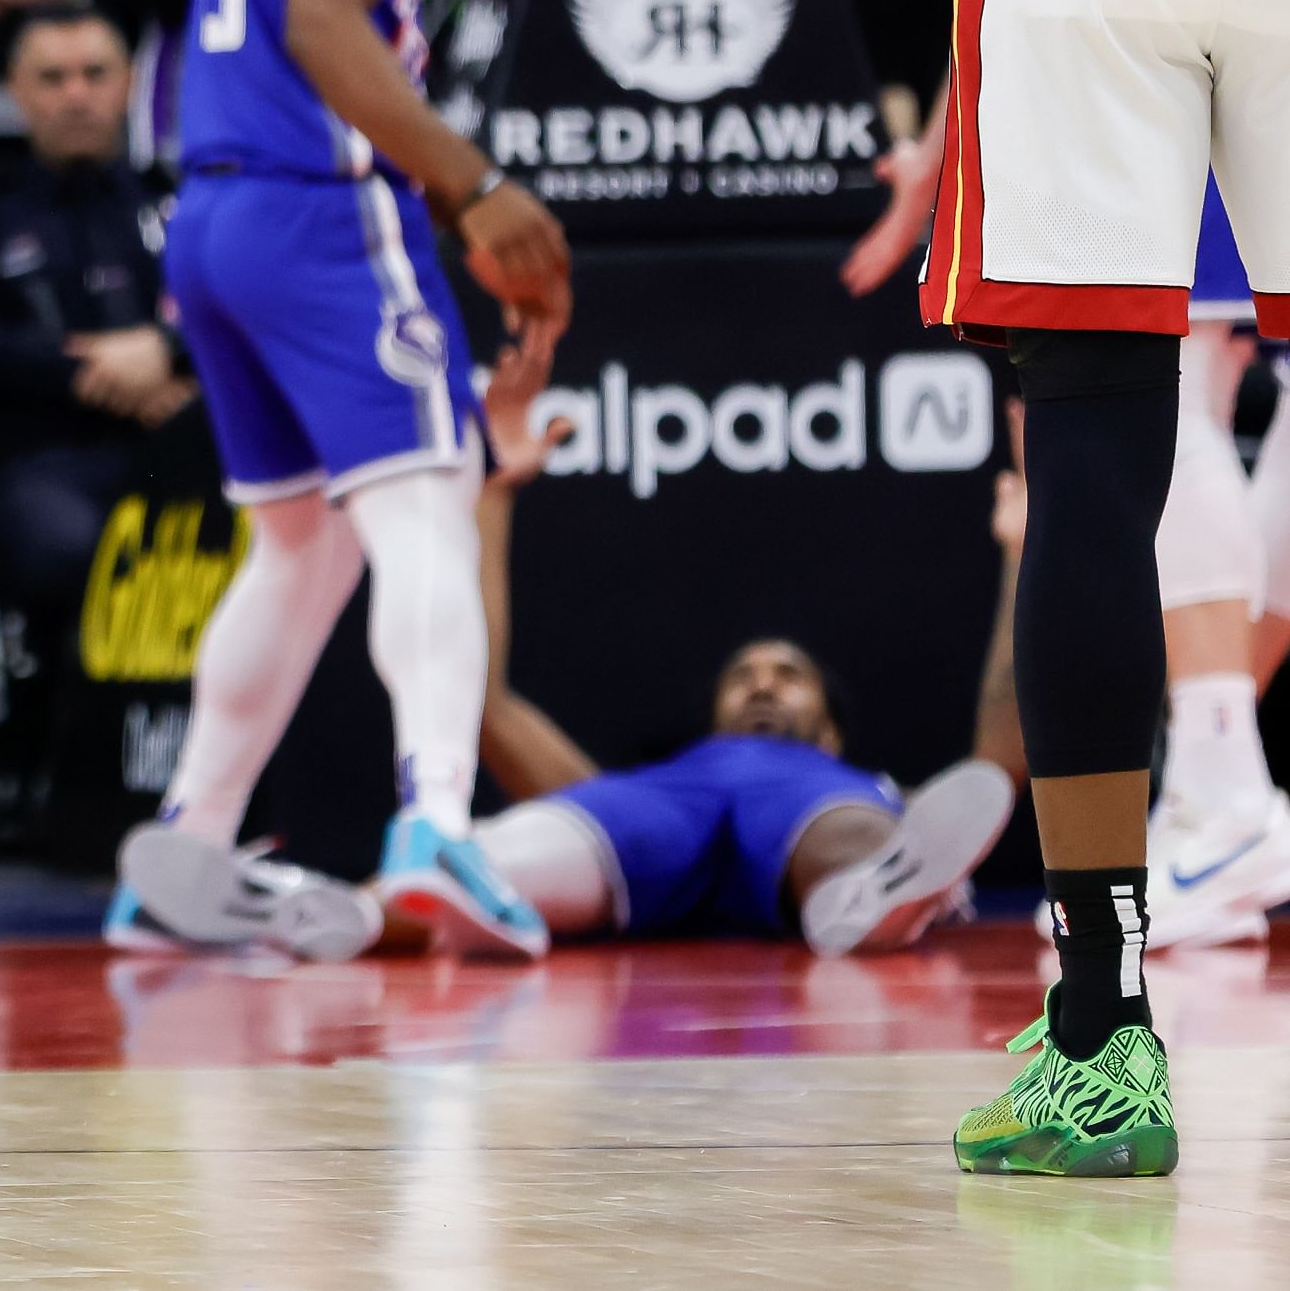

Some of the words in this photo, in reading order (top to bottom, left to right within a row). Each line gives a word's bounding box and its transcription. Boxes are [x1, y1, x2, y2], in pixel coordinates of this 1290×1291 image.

[489, 104, 877, 166] REDHAWK
[707, 160, 839, 198] CASINO
[472, 357, 867, 499] alpad
